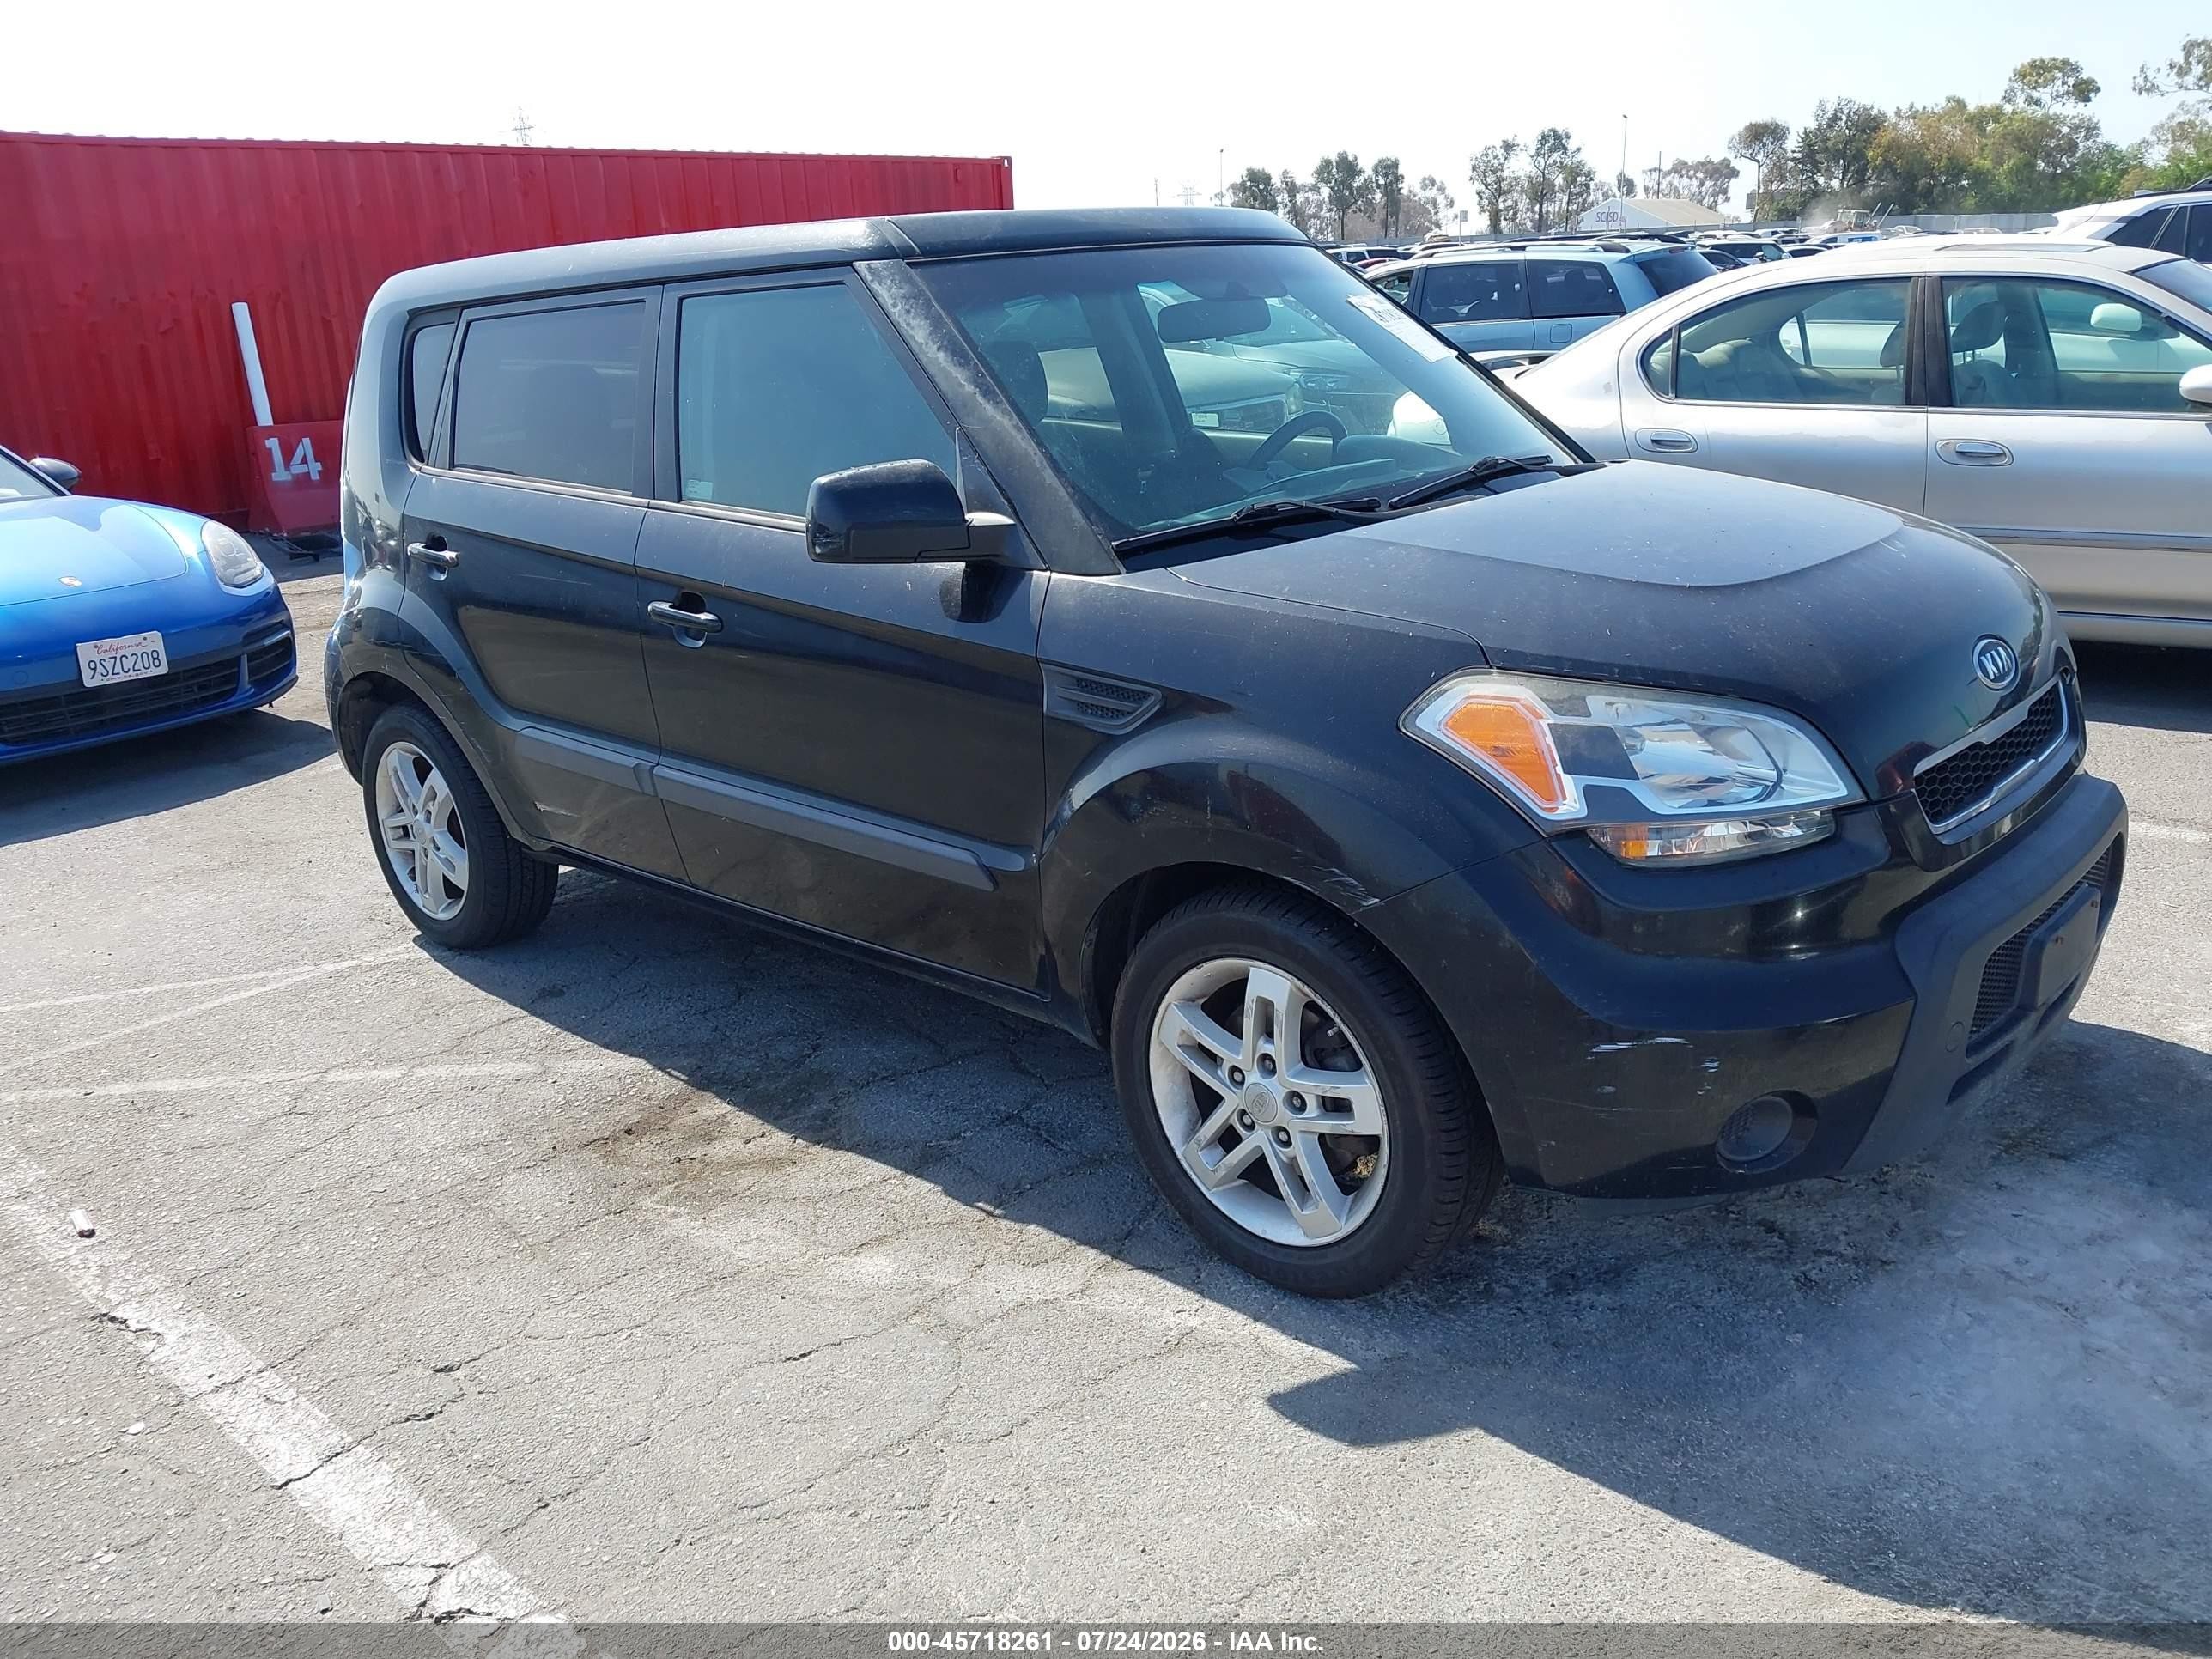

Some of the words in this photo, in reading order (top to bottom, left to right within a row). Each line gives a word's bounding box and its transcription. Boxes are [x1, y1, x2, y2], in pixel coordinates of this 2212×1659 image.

[264, 437, 323, 481] 14
[96, 641, 147, 655] California
[1979, 647, 2012, 680] KIA
[88, 649, 161, 680] 9SZC208
